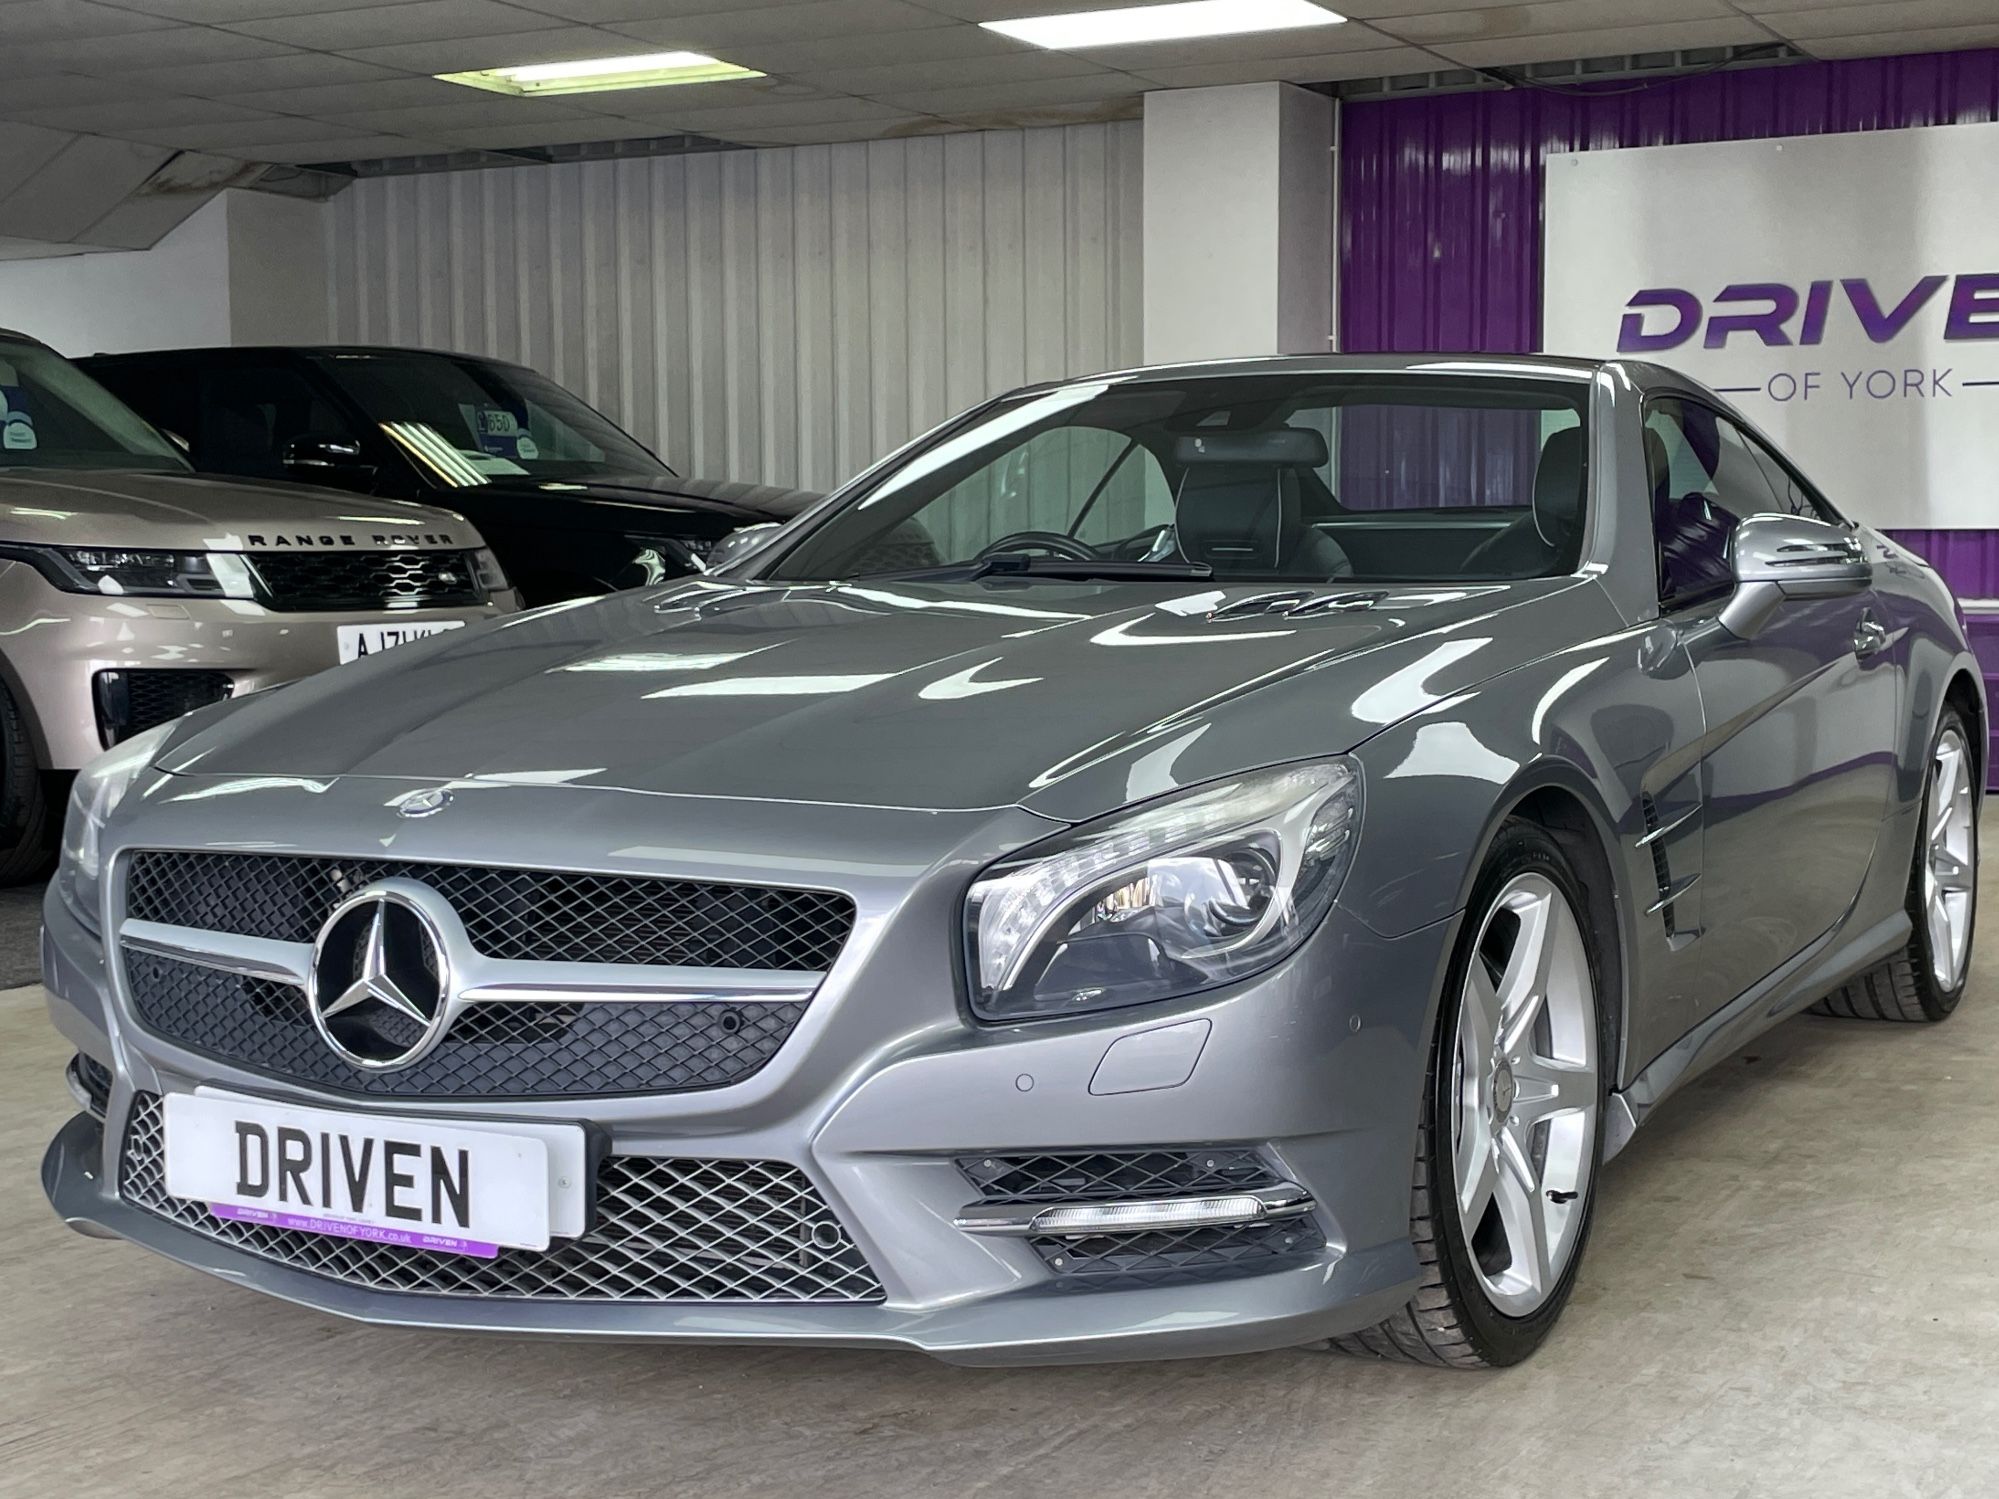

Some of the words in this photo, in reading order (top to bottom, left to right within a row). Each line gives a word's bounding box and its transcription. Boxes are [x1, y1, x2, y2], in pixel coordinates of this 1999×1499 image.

[1767, 371, 1822, 401] OF
[1840, 368, 1953, 401] YORK
[248, 534, 356, 547] RANGE
[371, 534, 454, 545] ROVER
[234, 1120, 470, 1229] DRIVEN
